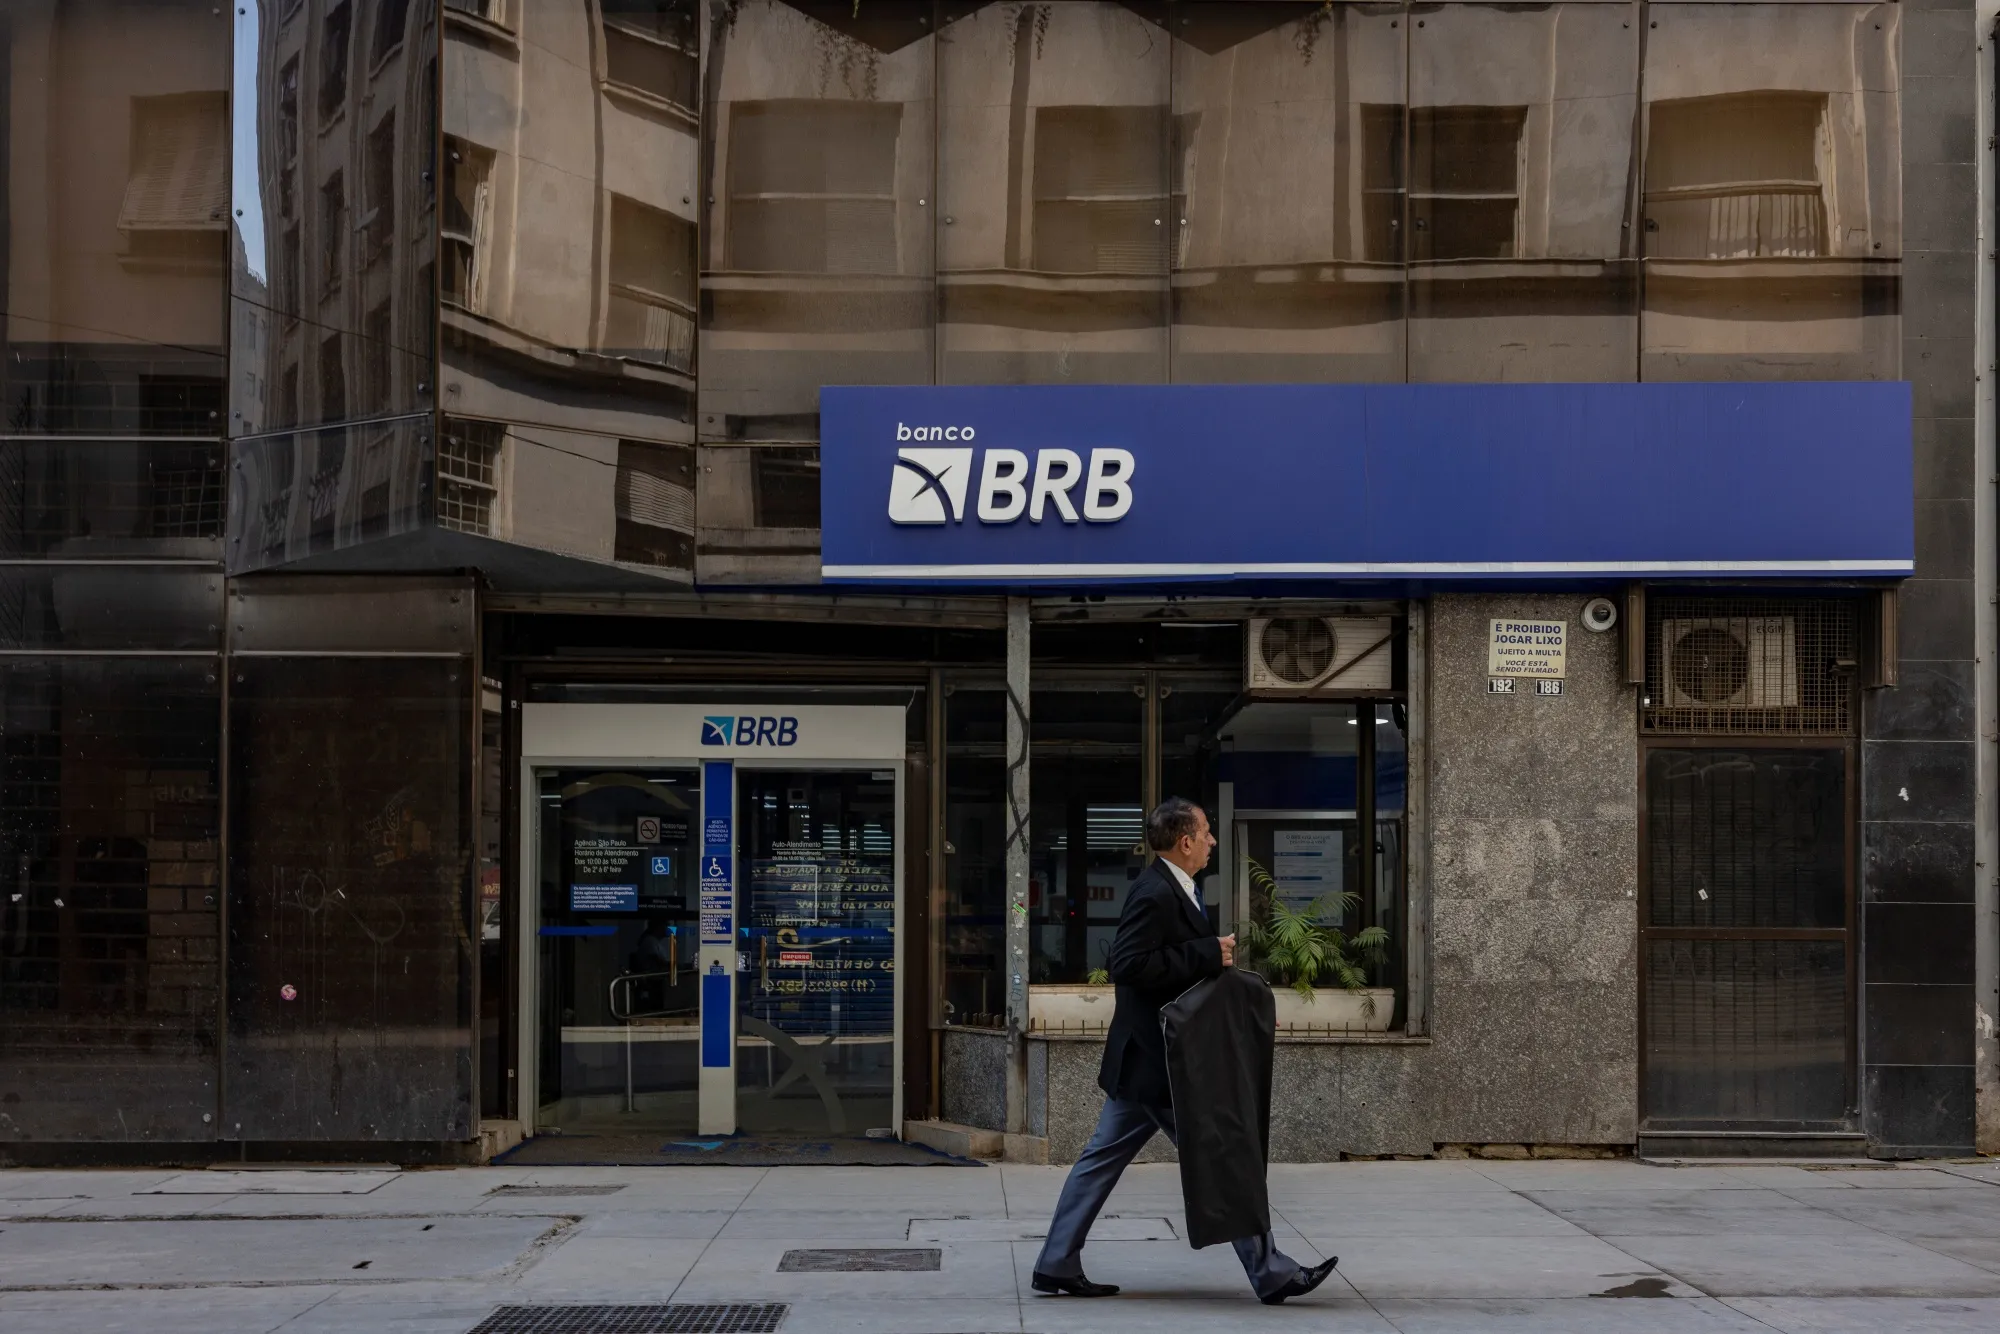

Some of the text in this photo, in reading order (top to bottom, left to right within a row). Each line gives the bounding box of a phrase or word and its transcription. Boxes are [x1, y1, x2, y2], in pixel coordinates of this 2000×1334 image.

[896, 422, 975, 441] banco
[977, 447, 1135, 523] BRB
[1495, 622, 1561, 634] É PROIBIDO
[1494, 635, 1562, 645] JOGAR LIXO
[1536, 649, 1562, 657] MULTA
[1505, 658, 1548, 667] VOCÊ ESTÁ
[1495, 665, 1558, 674] SENDO FILMADO
[1491, 679, 1513, 692] 192
[1539, 680, 1560, 694] 186
[735, 716, 799, 747] BRB
[574, 840, 597, 848] Agência
